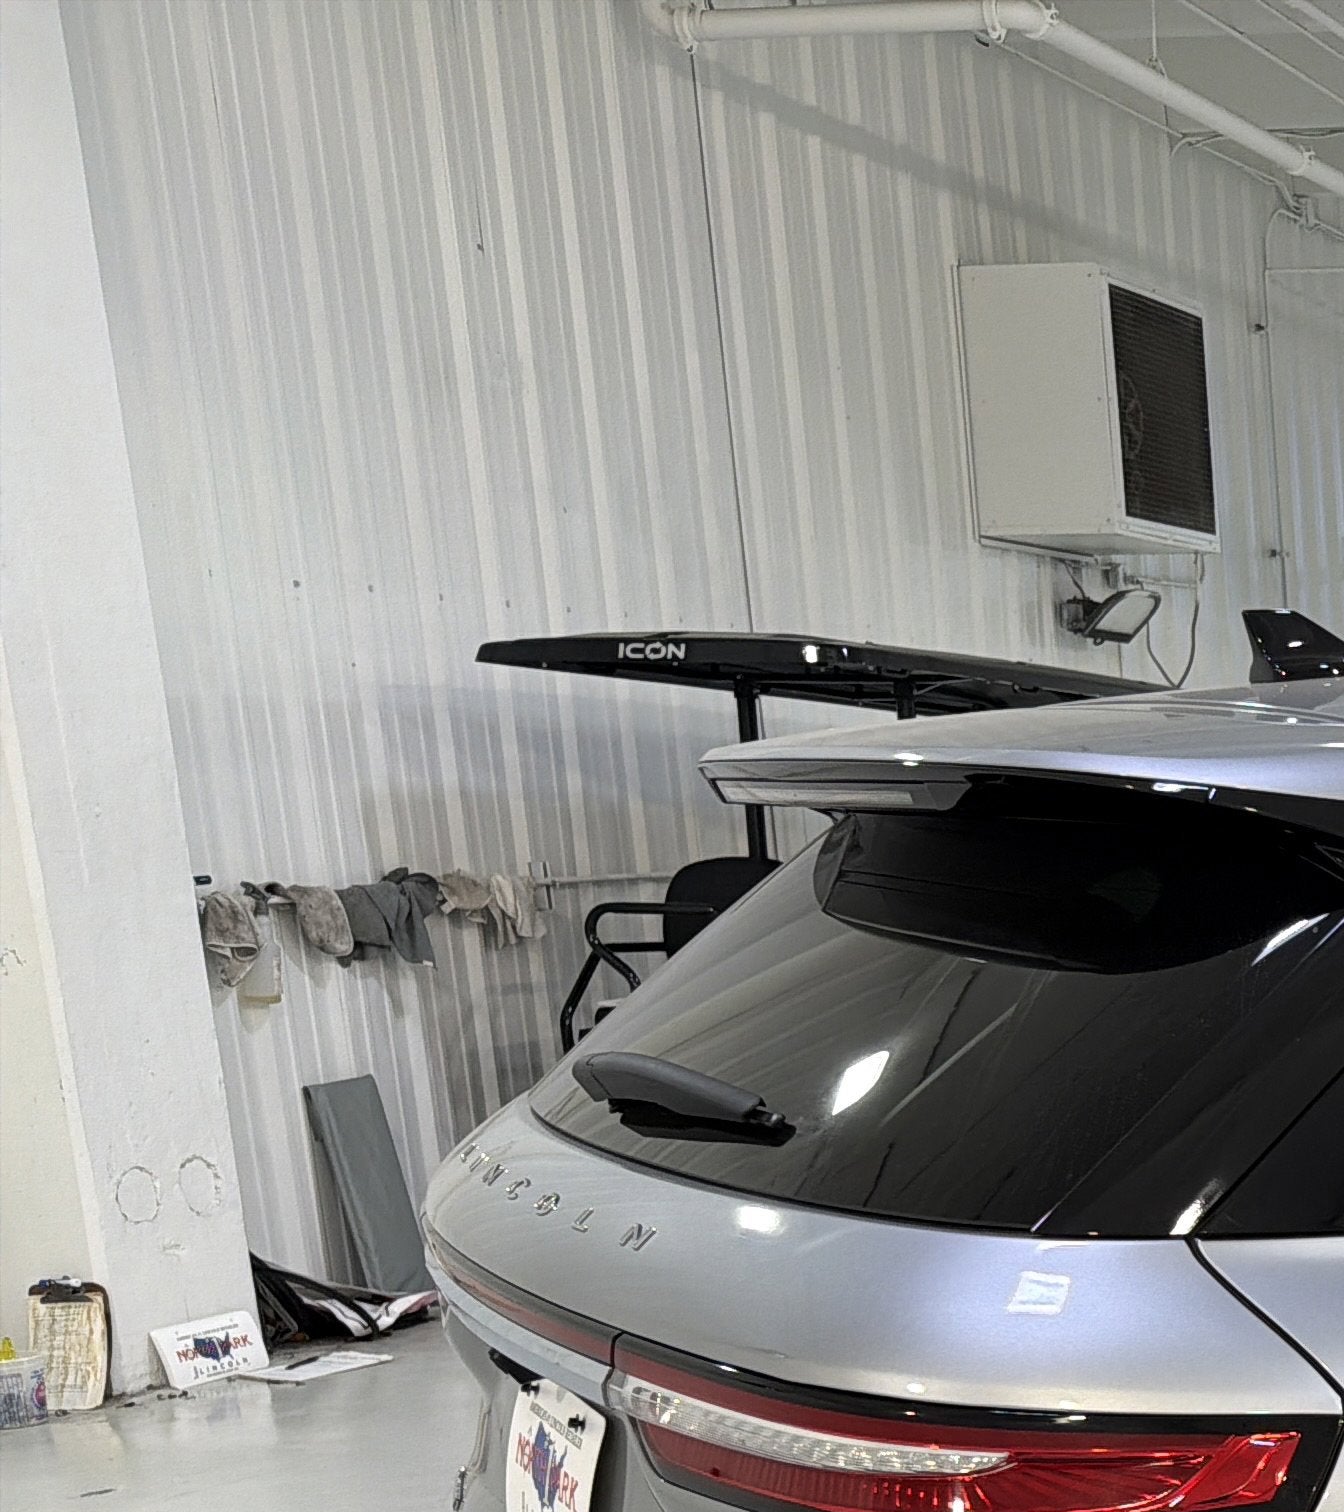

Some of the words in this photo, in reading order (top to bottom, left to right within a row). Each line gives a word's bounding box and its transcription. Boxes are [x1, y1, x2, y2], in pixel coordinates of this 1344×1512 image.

[618, 641, 686, 660] ICON
[459, 1143, 657, 1251] LINCOLN
[199, 1357, 249, 1375] LINCOLN
[515, 1432, 550, 1487] NORTH
